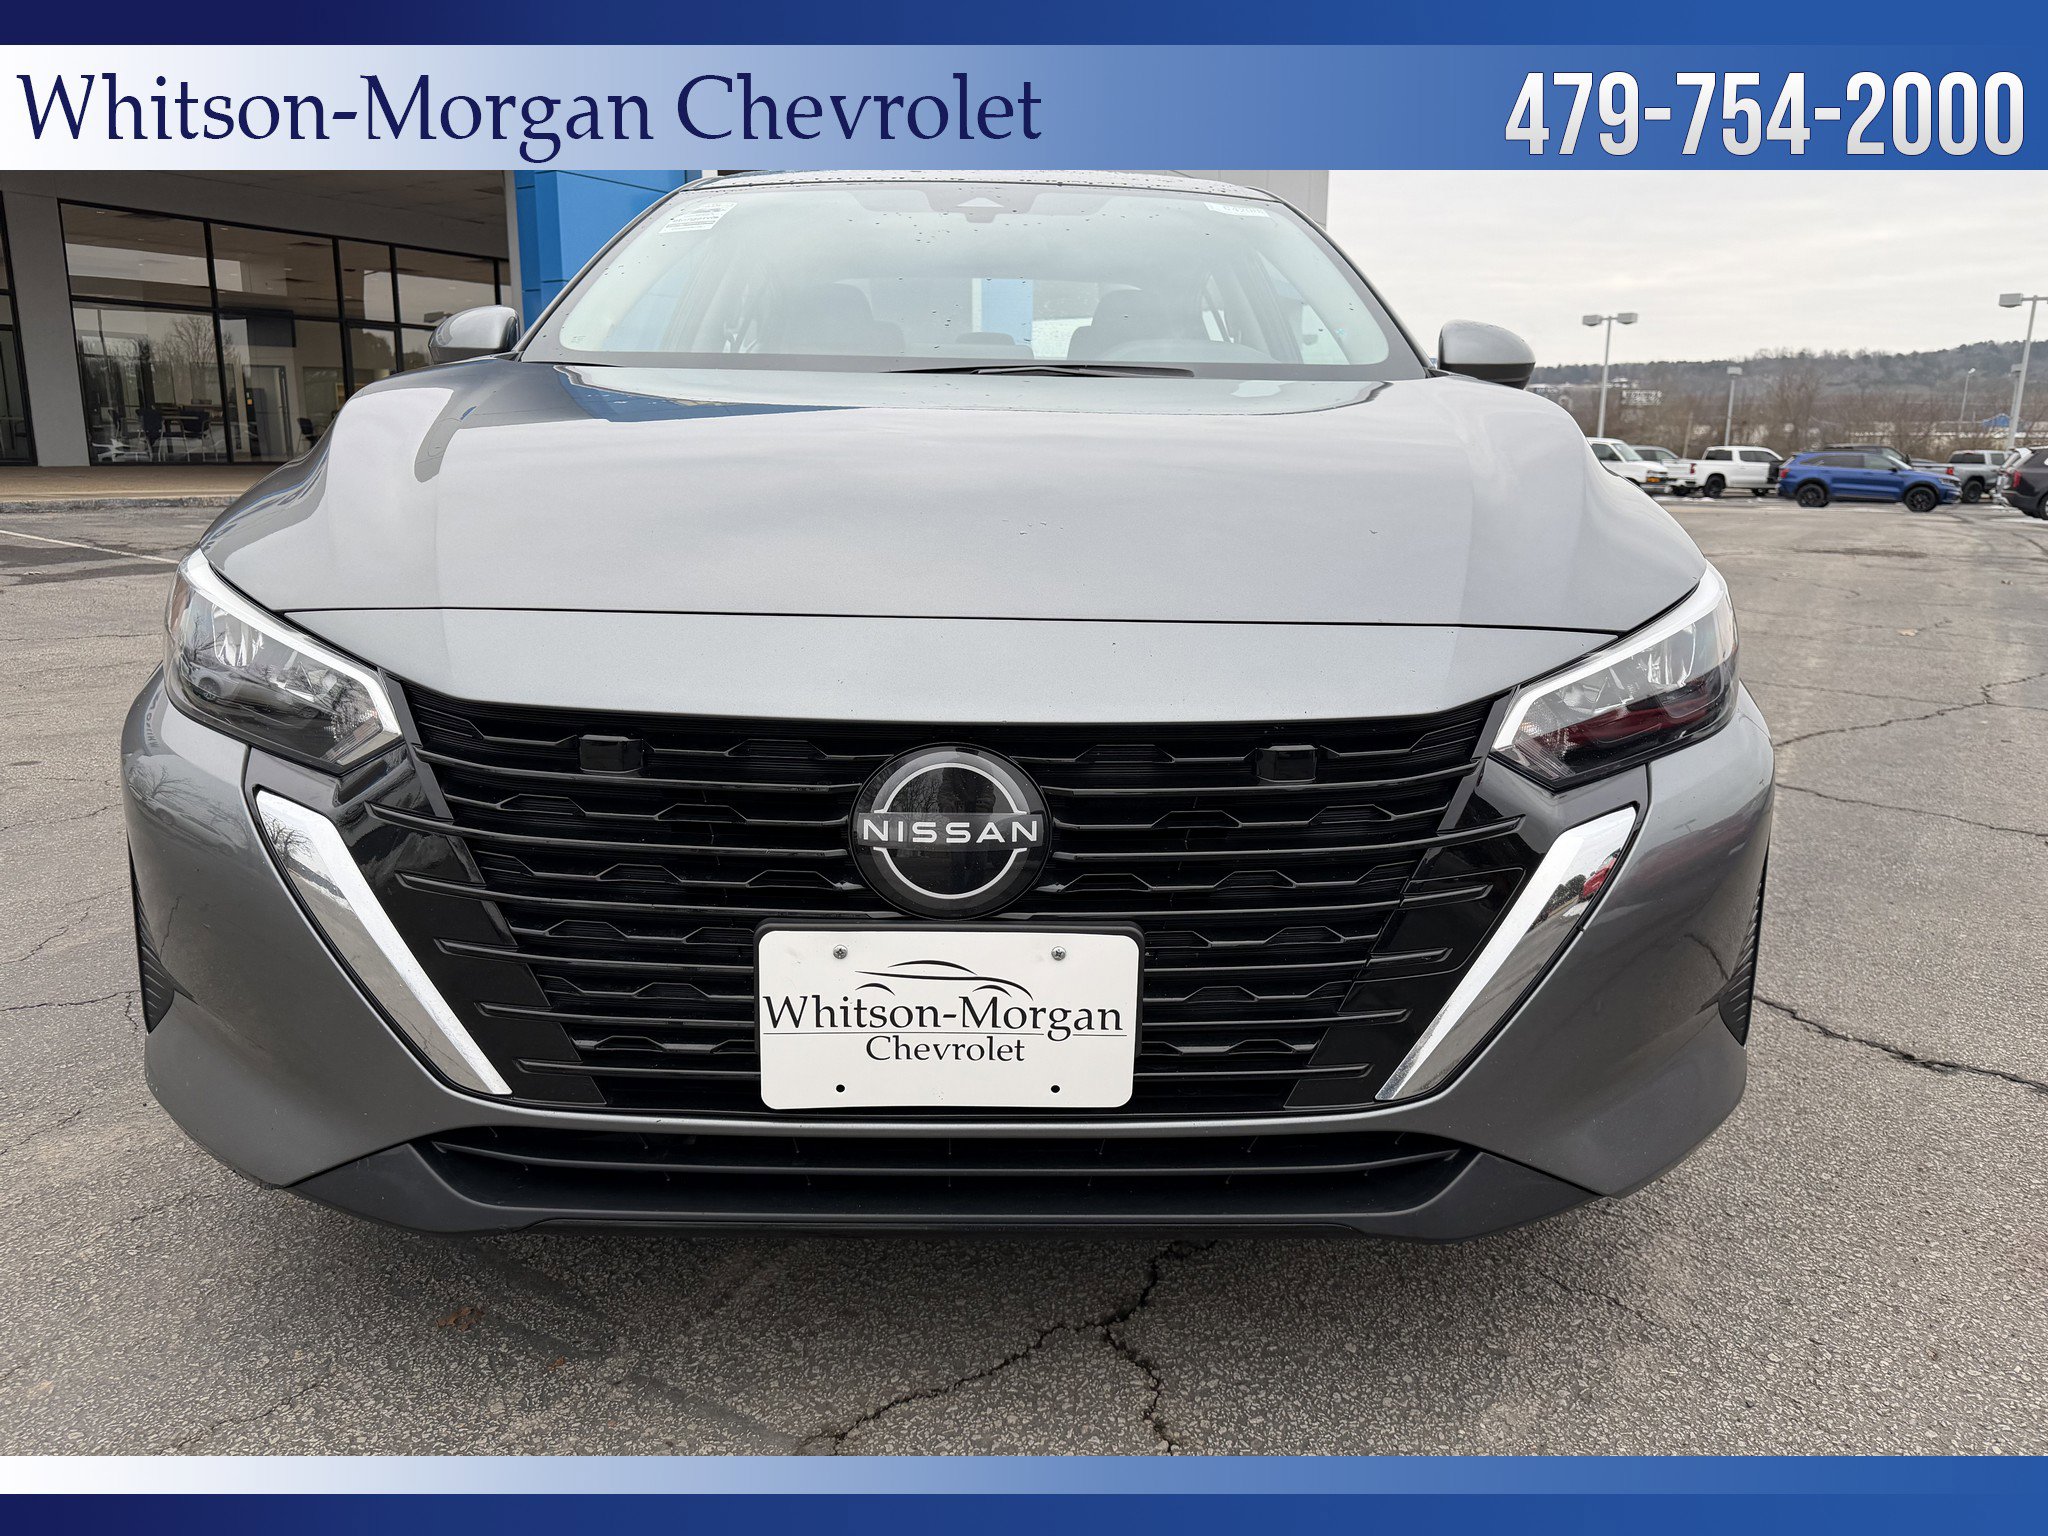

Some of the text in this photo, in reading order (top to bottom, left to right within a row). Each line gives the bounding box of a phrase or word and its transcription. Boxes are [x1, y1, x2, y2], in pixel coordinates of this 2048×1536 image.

[863, 819, 1038, 844] NISSAN
[762, 995, 1123, 1042] Whitson-Morgan
[866, 1036, 1025, 1062] Chevrolet
